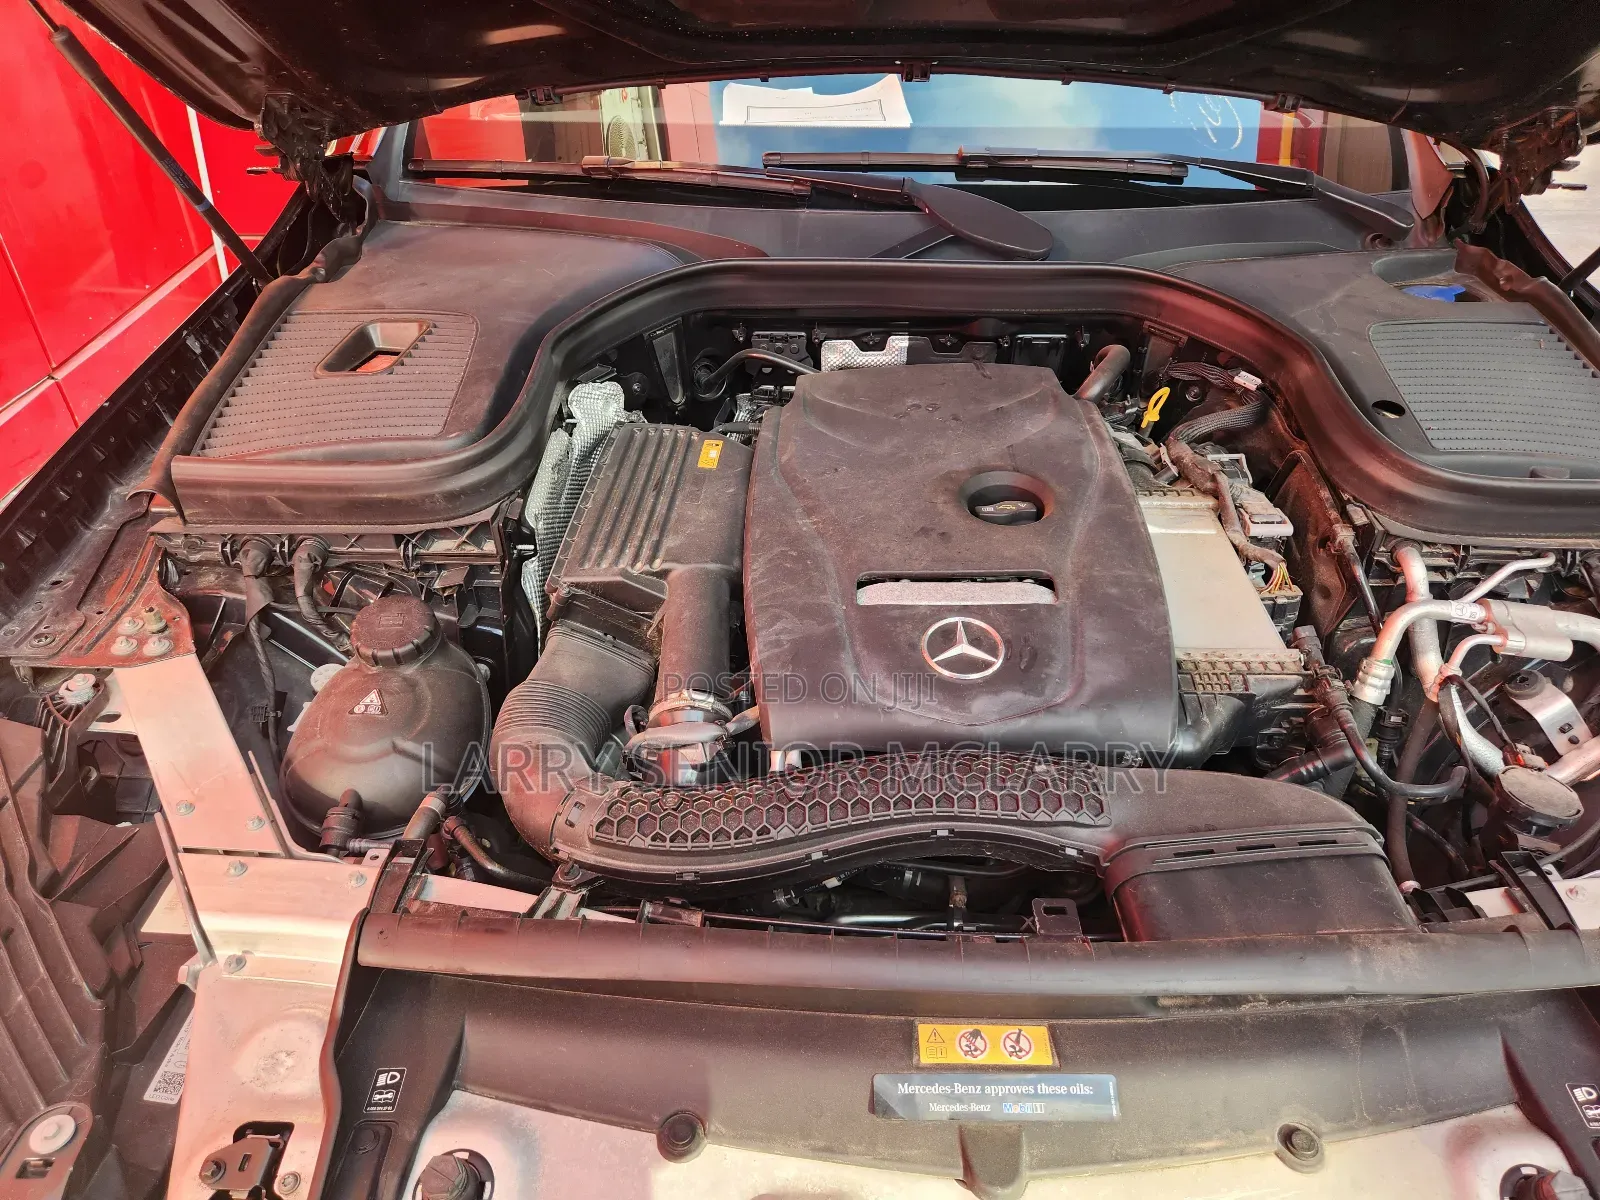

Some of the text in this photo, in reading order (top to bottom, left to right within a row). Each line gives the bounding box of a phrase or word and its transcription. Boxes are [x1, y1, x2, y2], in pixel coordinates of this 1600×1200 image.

[898, 1083, 1094, 1097] Mercedes-Benz approves these oils:
[929, 1102, 991, 1112] Mercedes-Benz
[1002, 1102, 1033, 1114] Mobil
